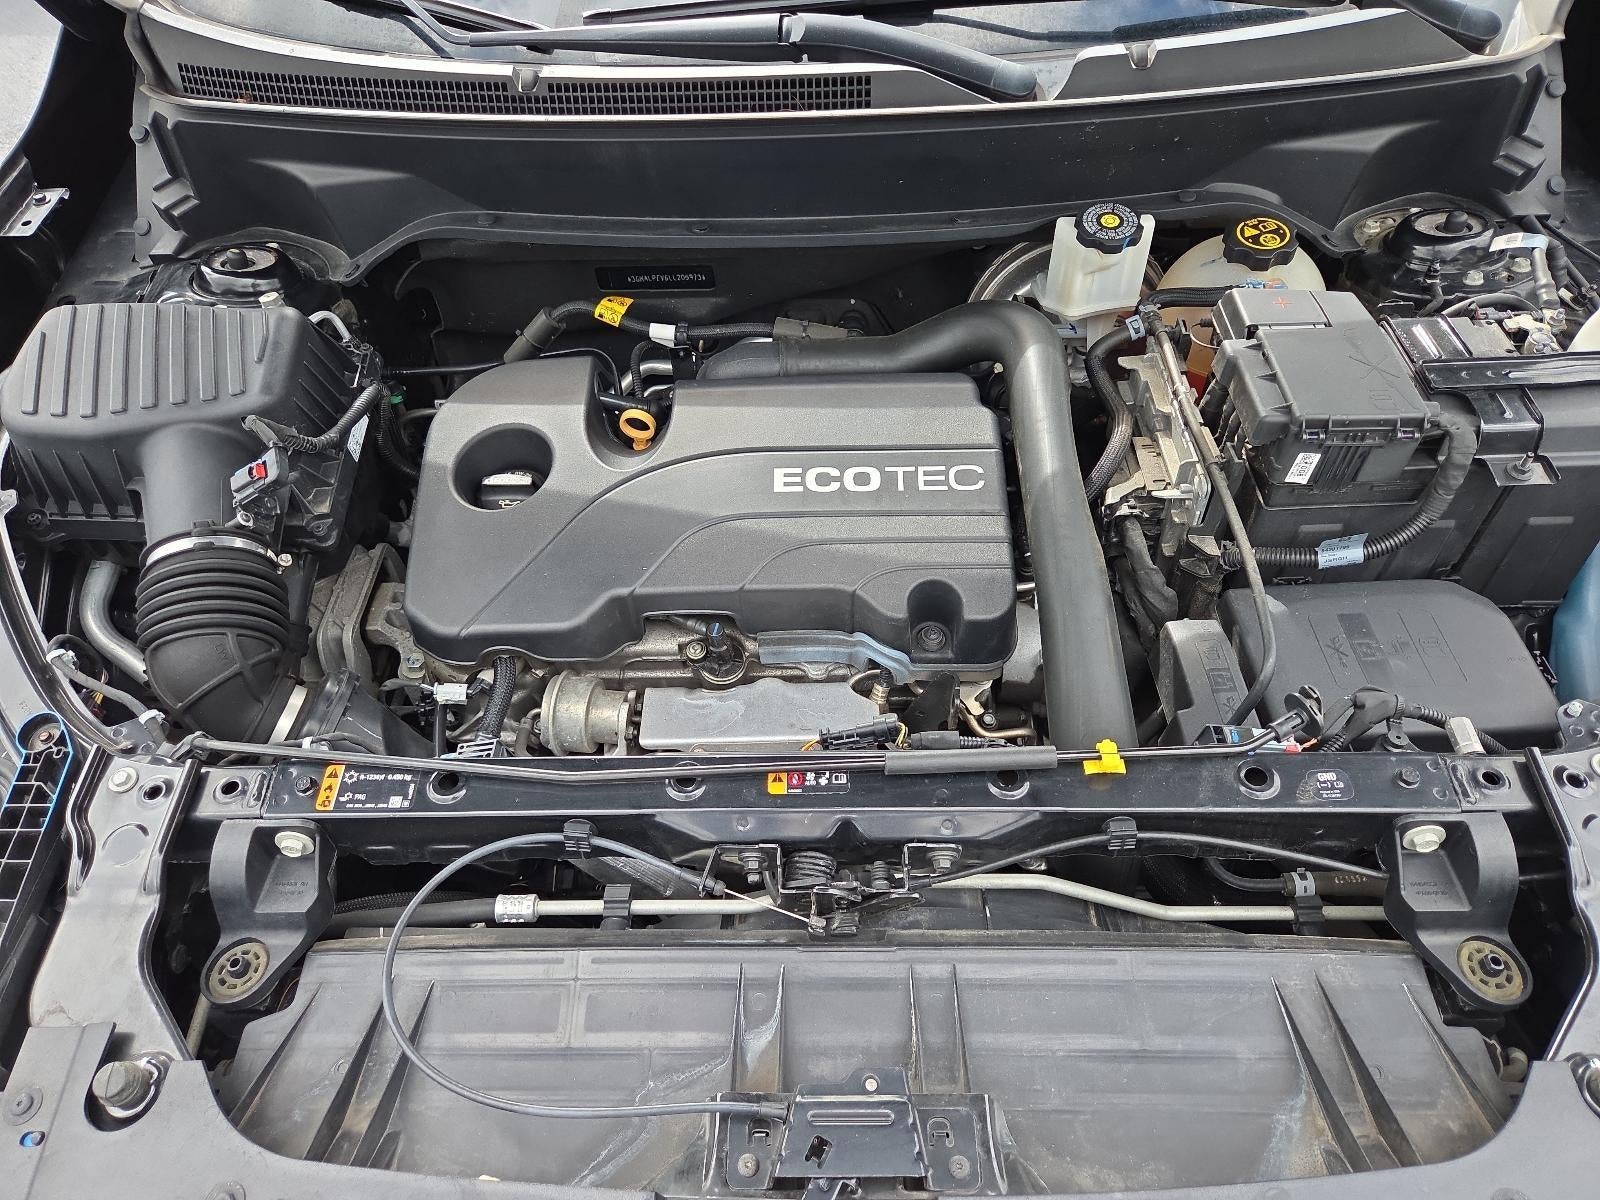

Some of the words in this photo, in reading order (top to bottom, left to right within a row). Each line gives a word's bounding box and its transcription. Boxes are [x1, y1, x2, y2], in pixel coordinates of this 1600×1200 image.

[773, 464, 985, 493] ECOTEC
[1317, 772, 1337, 781] GND
[354, 793, 367, 801] PAG
